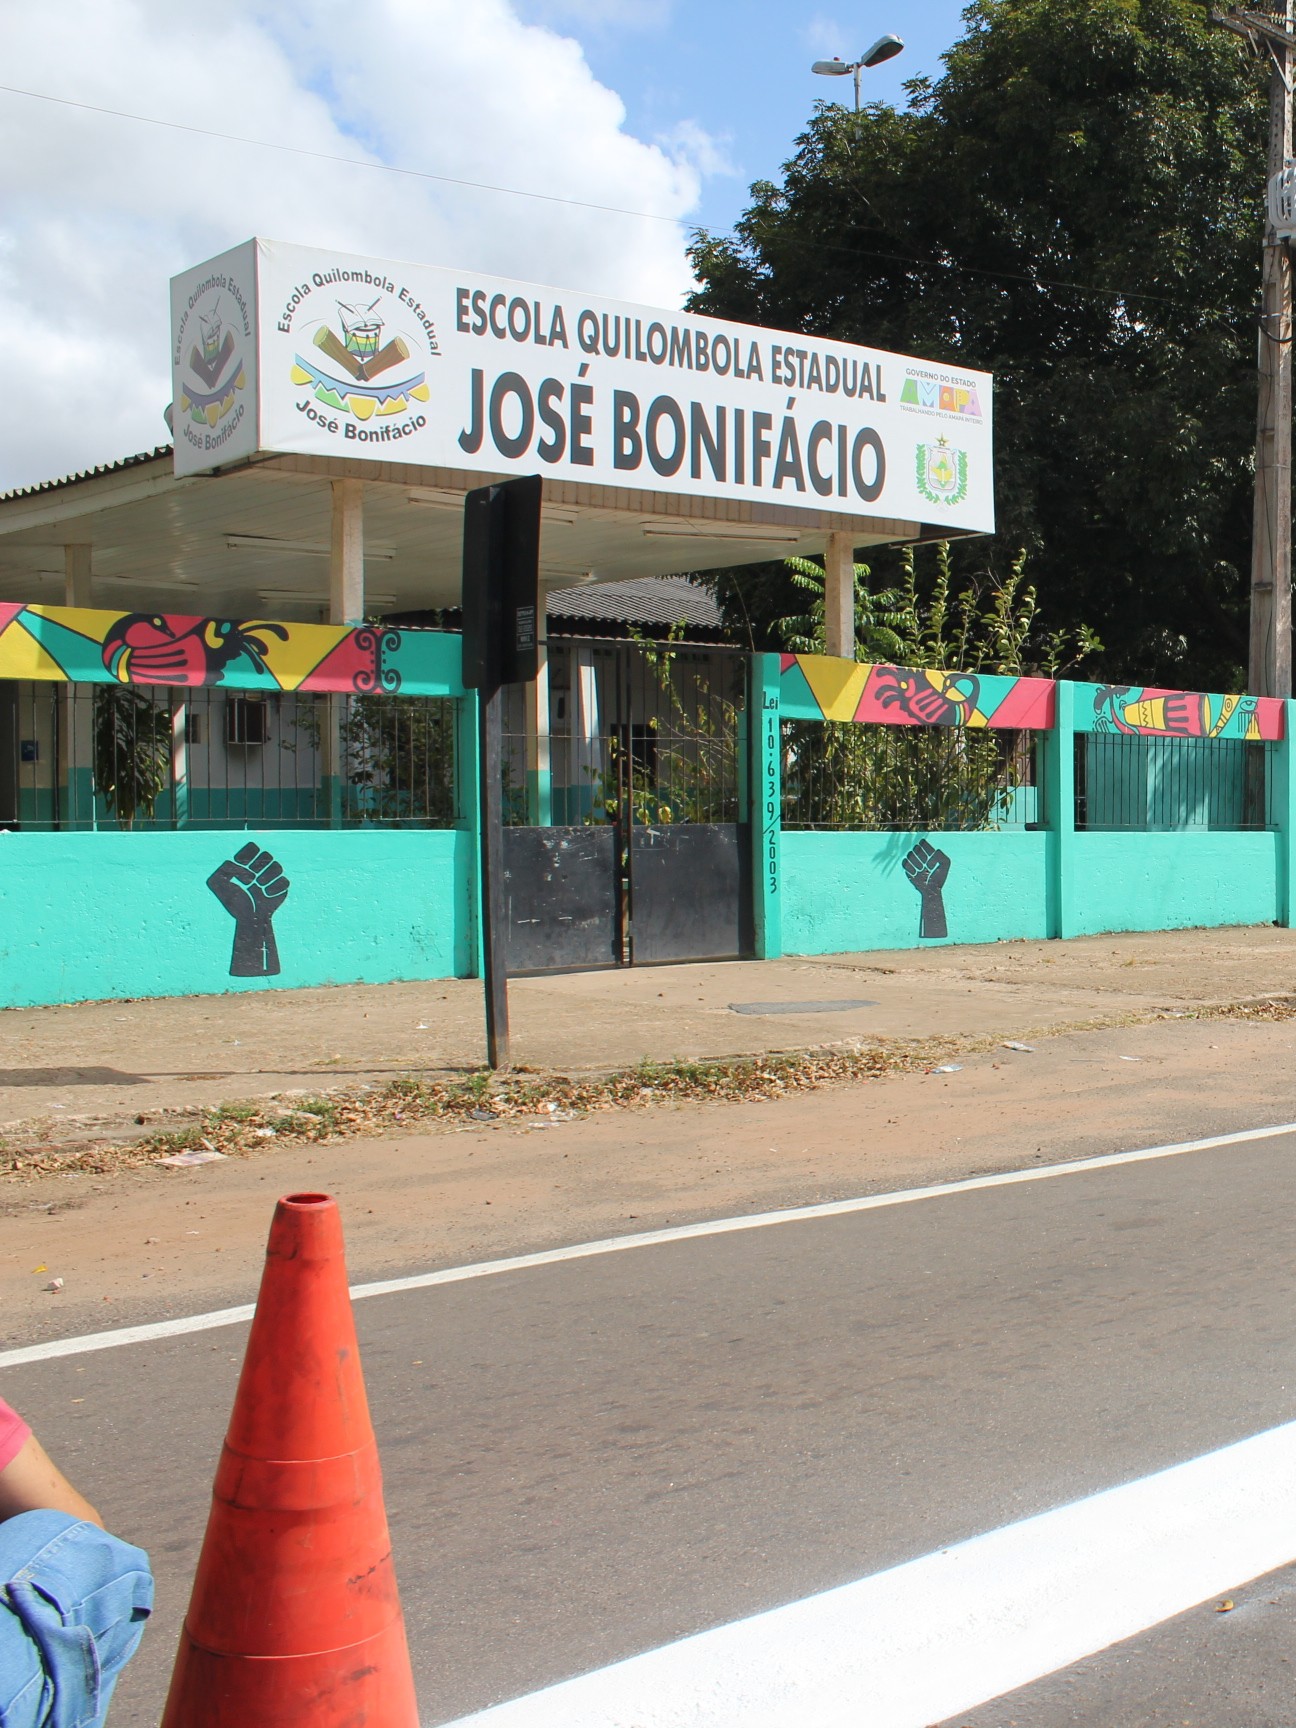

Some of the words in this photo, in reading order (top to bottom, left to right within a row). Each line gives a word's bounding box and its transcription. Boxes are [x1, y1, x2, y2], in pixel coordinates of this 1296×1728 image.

[175, 312, 189, 365] Escola
[188, 274, 227, 310] Quilombola
[227, 277, 251, 337] Estadual
[278, 283, 312, 333] Escola
[312, 268, 395, 294] Quilombola
[398, 288, 442, 356] Estadual
[456, 287, 569, 349] ESCOLA
[577, 309, 764, 382] QUILOMBOLA
[771, 344, 887, 403] ESTADUAL
[905, 368, 939, 381] GOVERNO
[939, 375, 950, 383] DO
[951, 377, 977, 388] ESTADO
[183, 423, 204, 449] José
[204, 404, 246, 450] Bonifácio
[296, 400, 339, 434] José
[344, 414, 427, 442] Bonifácio
[458, 362, 595, 466] JOSÉ
[613, 389, 887, 503] BONIFÁCIO
[899, 405, 936, 417] TRABALHANDO
[936, 411, 949, 419] PELO
[762, 691, 779, 710] Lei
